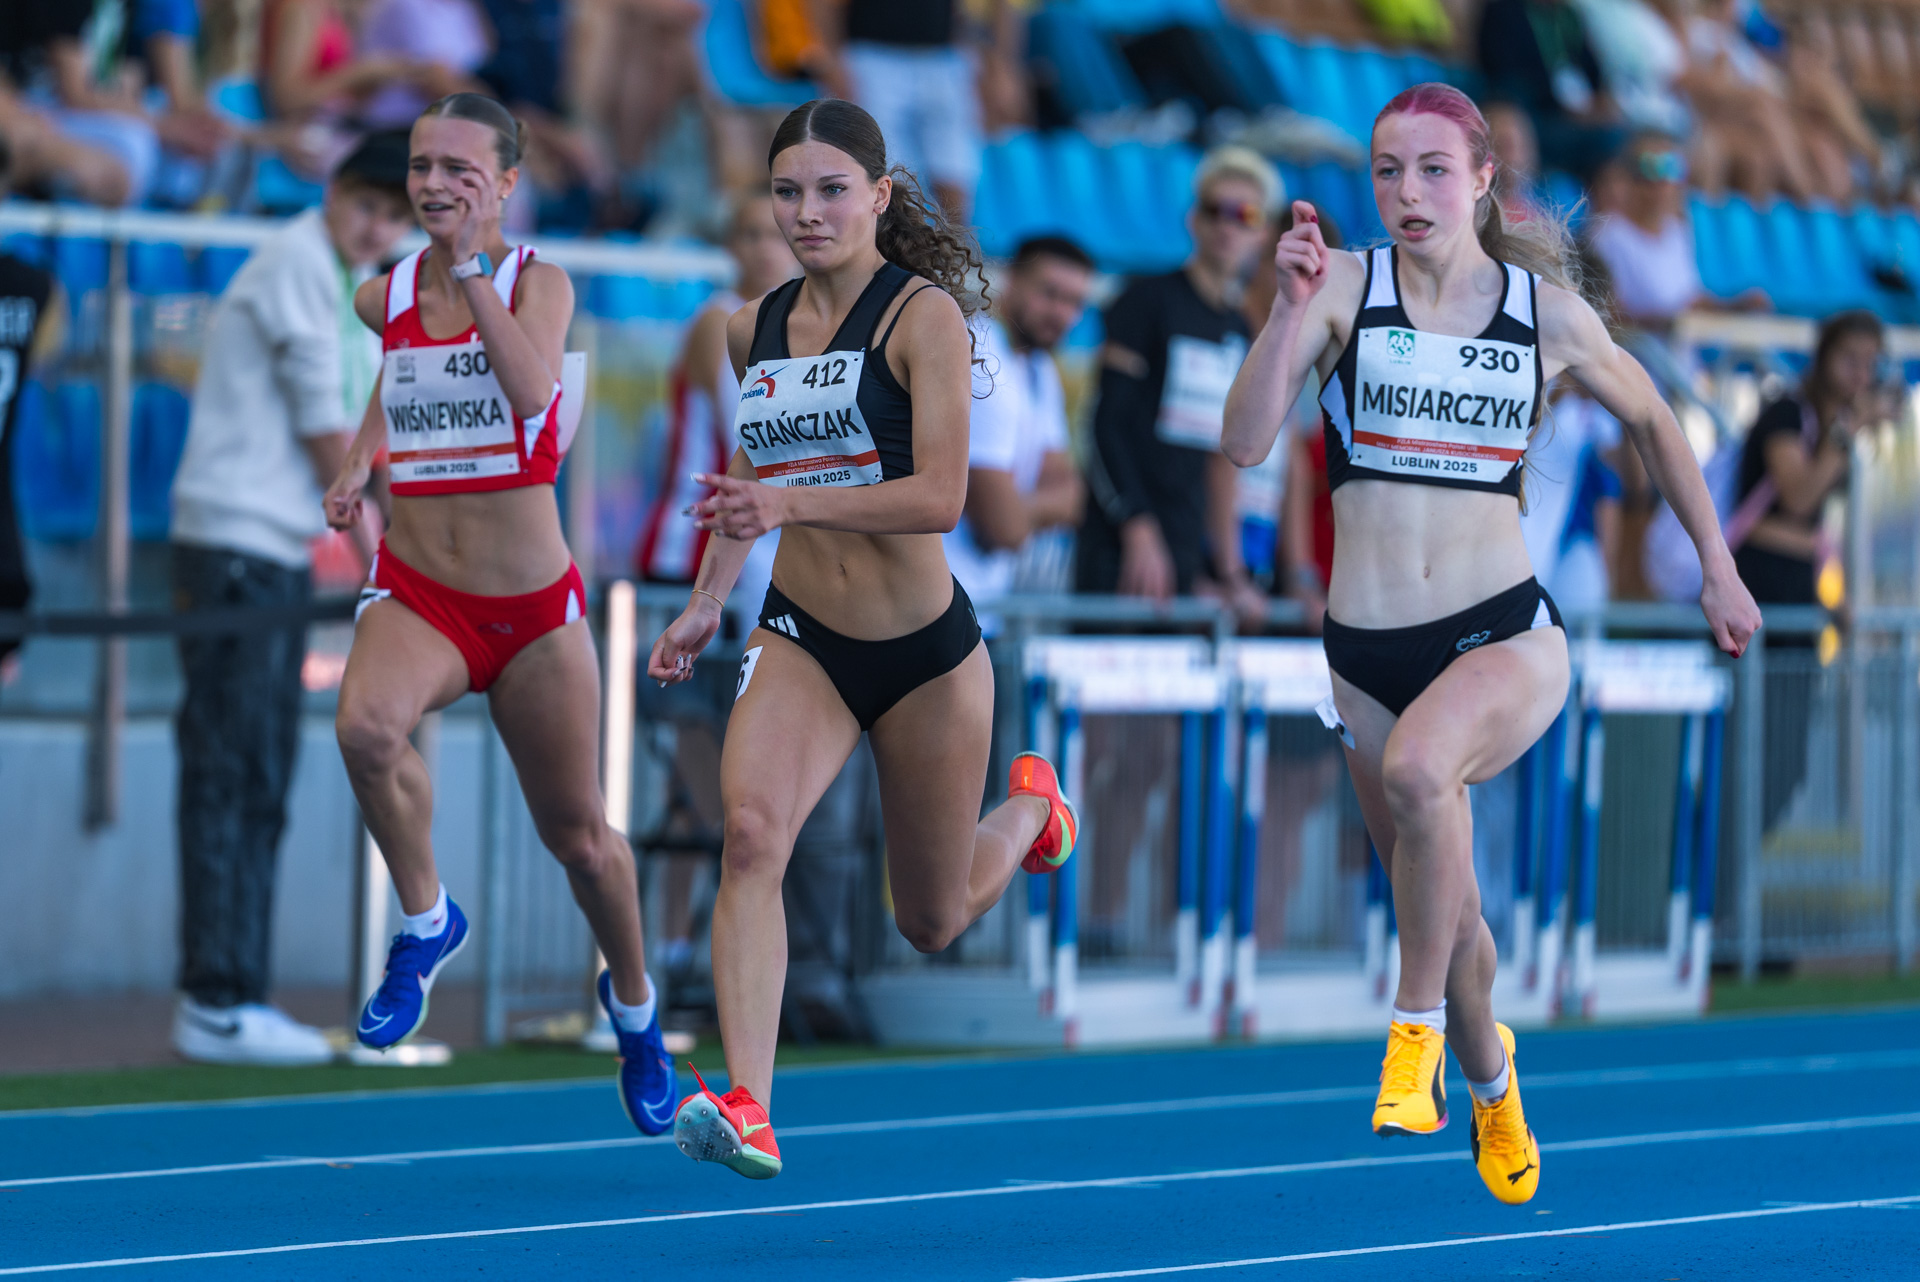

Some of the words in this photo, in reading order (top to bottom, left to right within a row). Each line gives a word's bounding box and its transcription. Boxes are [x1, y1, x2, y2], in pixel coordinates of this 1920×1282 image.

[444, 352, 491, 378] 430
[1458, 345, 1521, 374] 930
[802, 358, 848, 389] 412
[740, 386, 767, 403] polanik
[1362, 381, 1527, 430] MISIARCZYK
[387, 397, 505, 434] WIŚNIEWSKA
[740, 407, 863, 451] STAŃCZAK
[414, 464, 447, 476] LUBLIN
[448, 461, 478, 475] 2025
[1391, 455, 1440, 470] LUBLIN
[1442, 459, 1478, 474] 2025
[786, 474, 822, 488] LUBLIN
[822, 470, 851, 484] 2025
